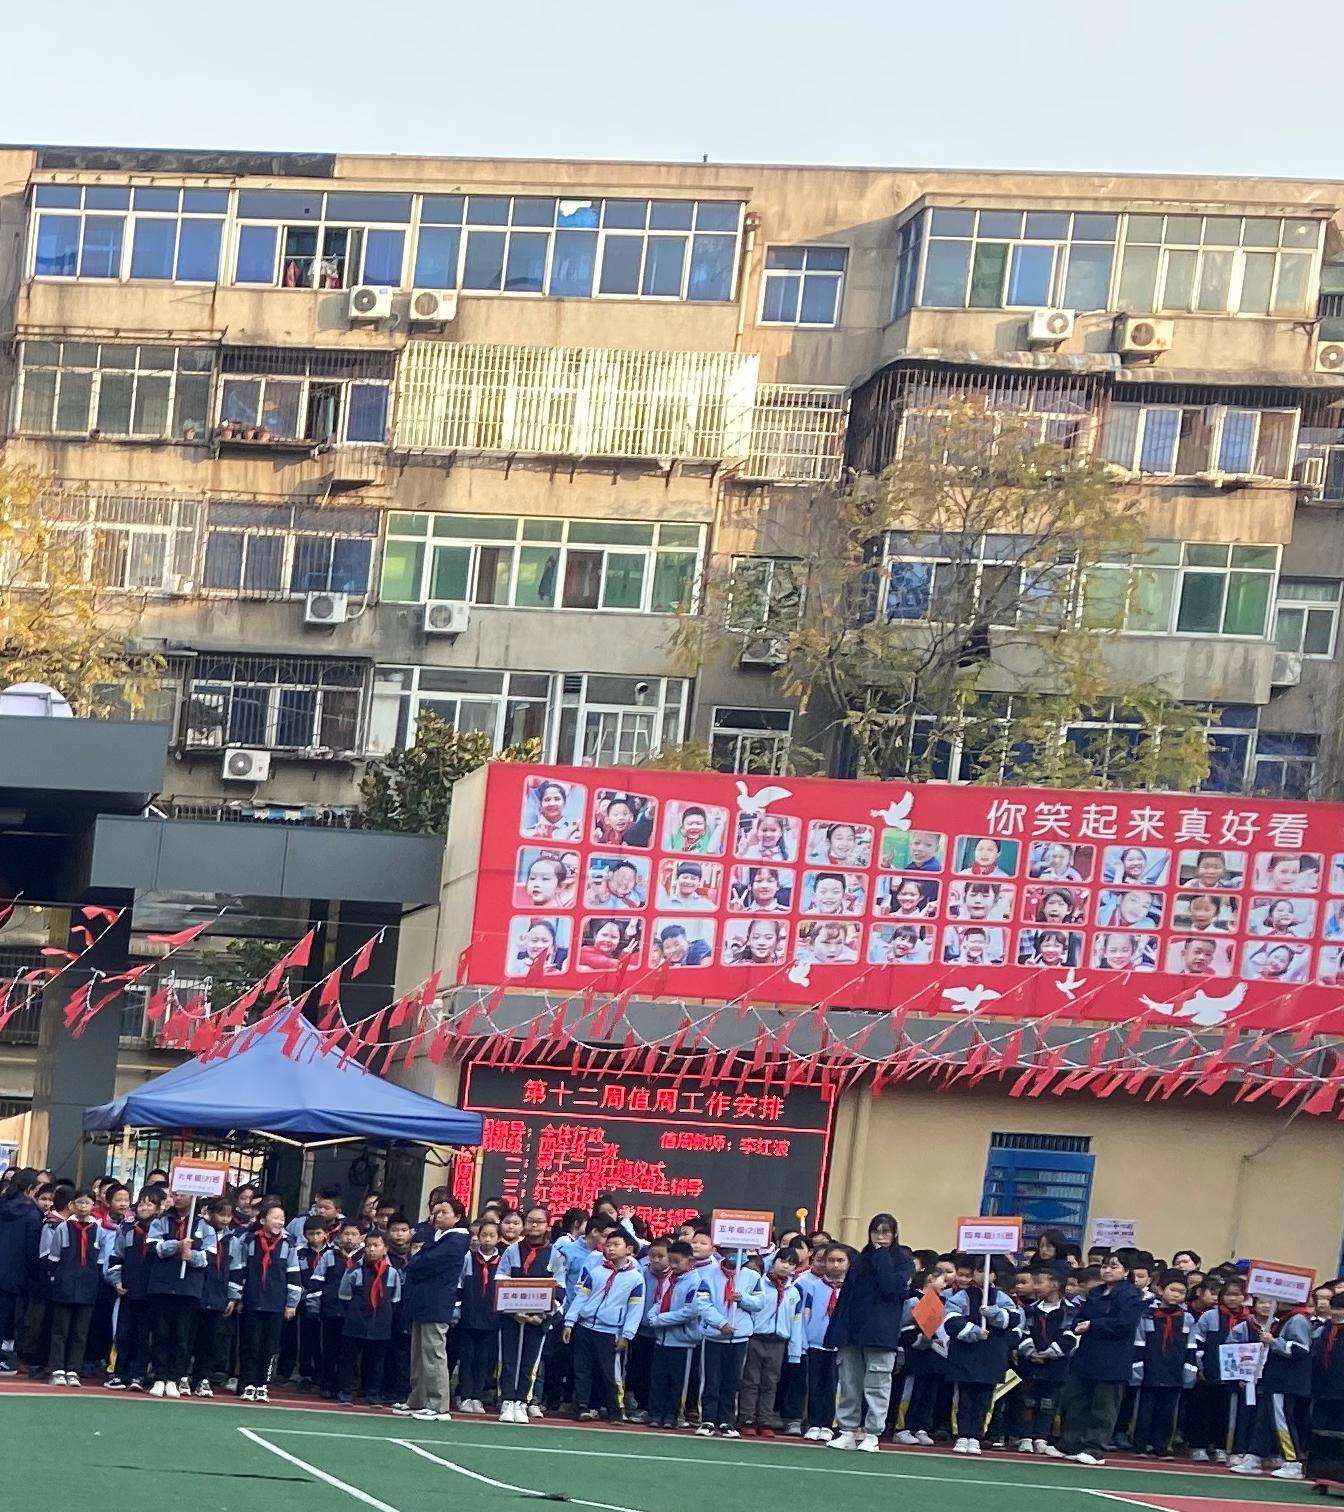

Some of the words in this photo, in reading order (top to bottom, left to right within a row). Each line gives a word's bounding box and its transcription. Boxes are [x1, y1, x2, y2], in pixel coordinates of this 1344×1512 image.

[986, 799, 1309, 849] 你笑起来真好看
[522, 1078, 785, 1120] 第十二周值周工作安排
